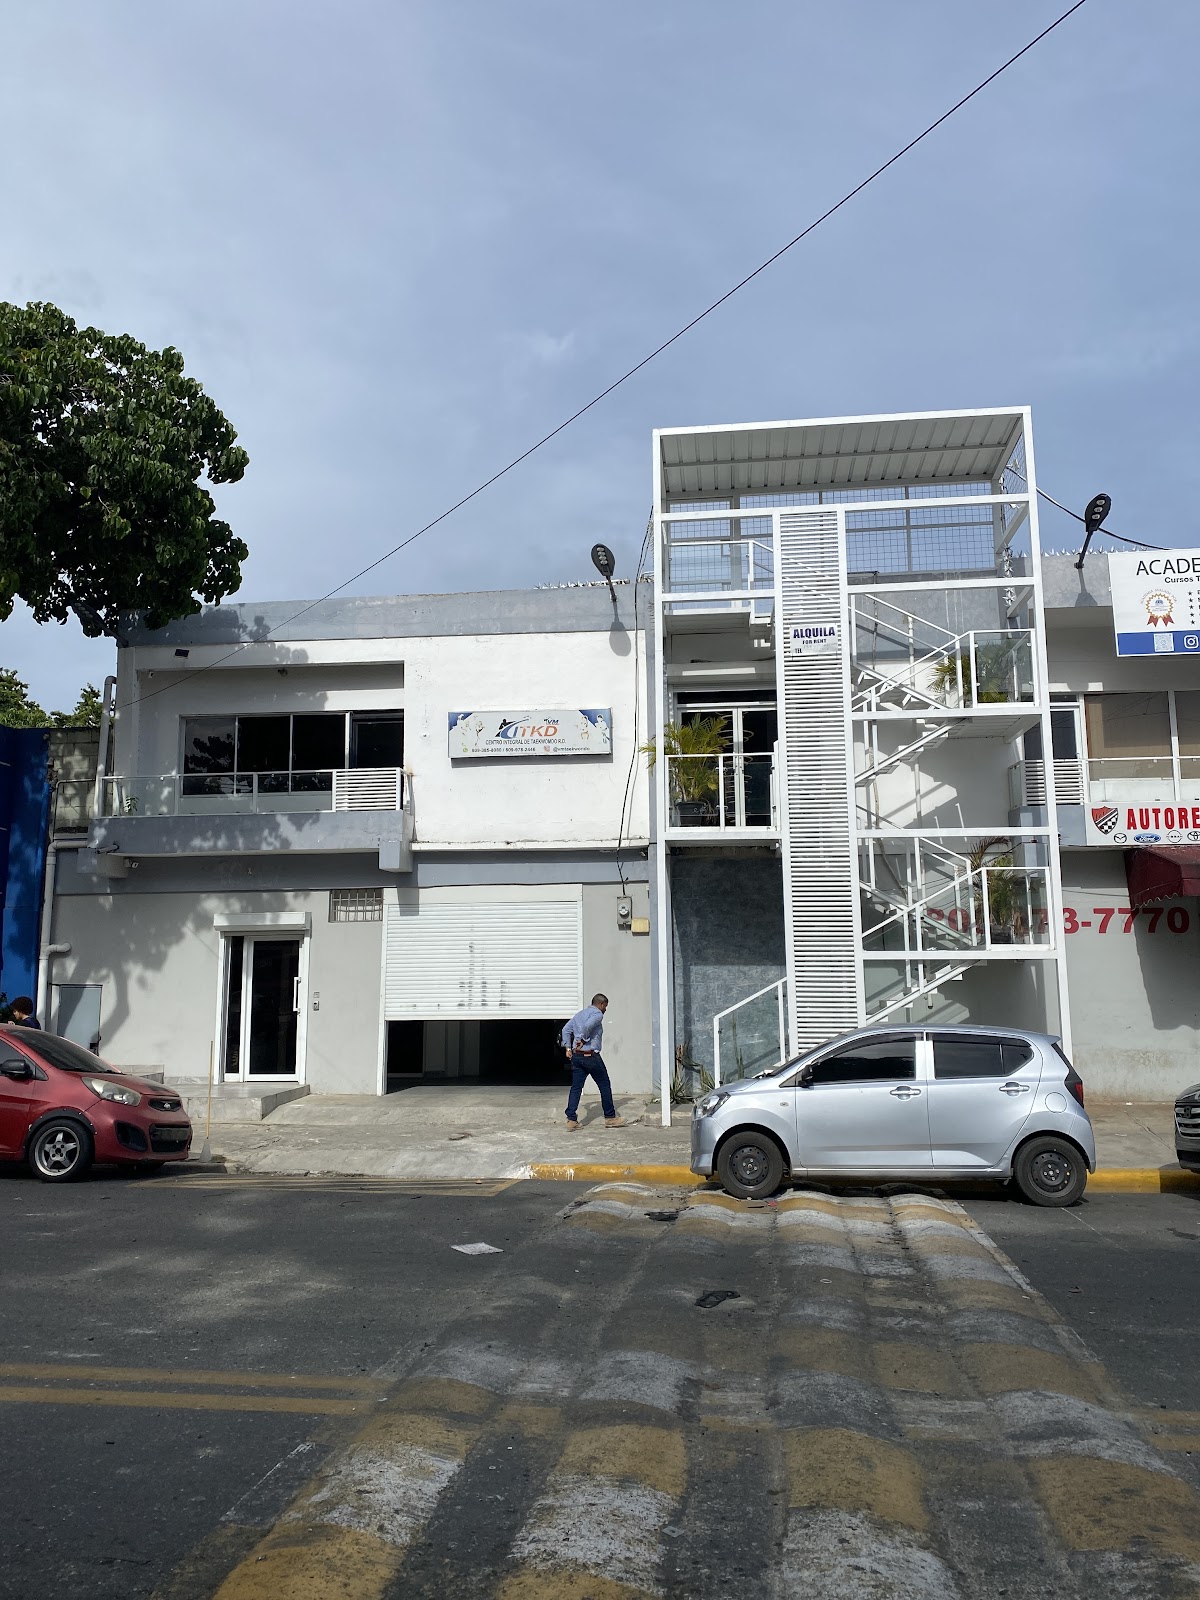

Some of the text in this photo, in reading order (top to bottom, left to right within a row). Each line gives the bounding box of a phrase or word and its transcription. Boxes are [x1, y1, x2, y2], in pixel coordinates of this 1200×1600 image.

[1136, 557, 1200, 576] ACADE
[1164, 576, 1194, 584] Cursos
[793, 626, 835, 638] ALQUILA
[1127, 807, 1200, 830] AUTORE
